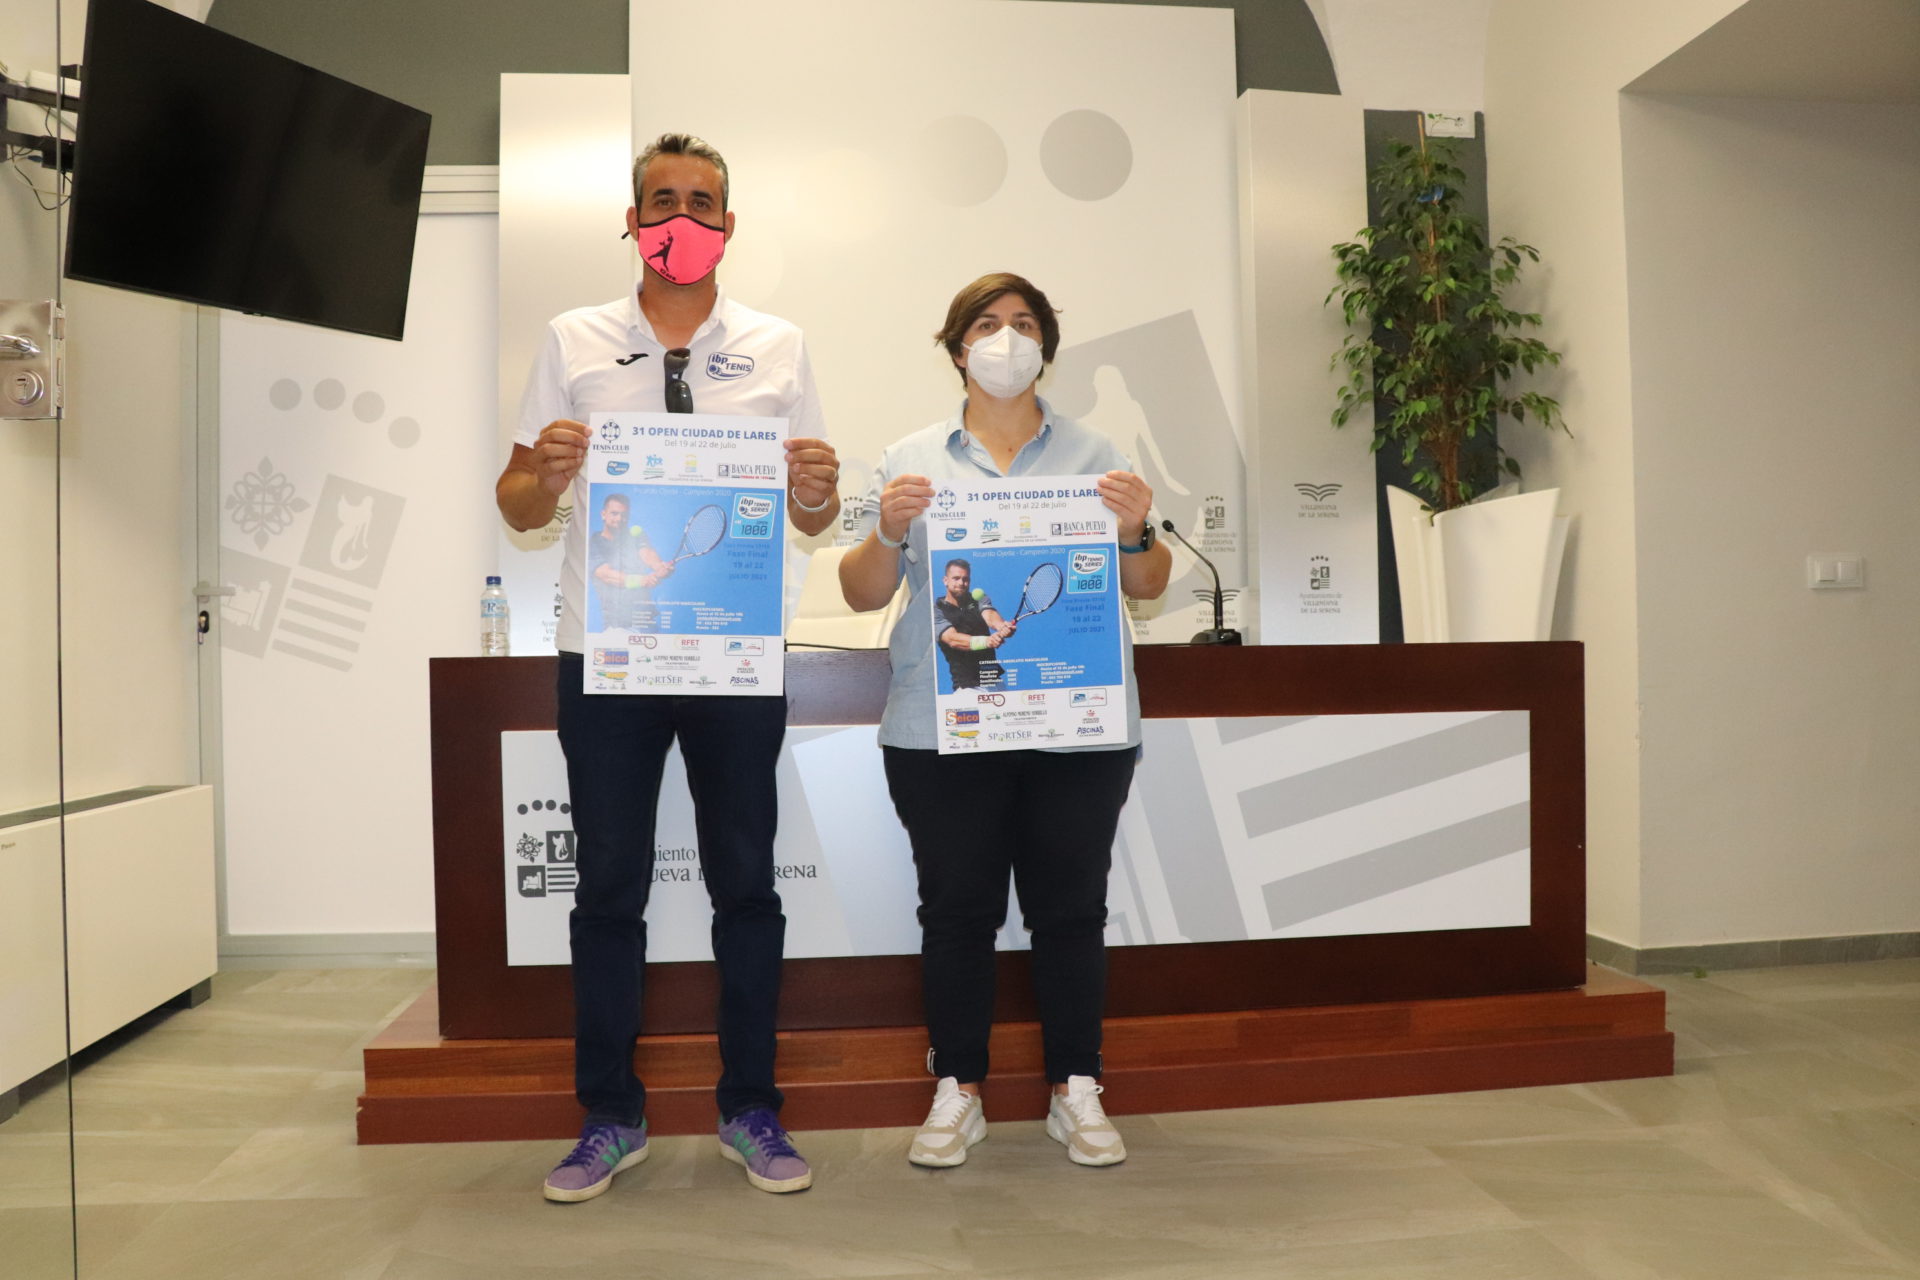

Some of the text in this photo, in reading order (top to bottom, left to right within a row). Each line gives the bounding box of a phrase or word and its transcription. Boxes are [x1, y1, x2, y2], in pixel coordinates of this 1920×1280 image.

[711, 353, 728, 364] ibp
[725, 363, 752, 372] TENIS
[632, 427, 777, 441] 31 OPEN CIUDAD DE LARES
[664, 439, 677, 447] Del
[679, 440, 689, 448] 19
[690, 440, 697, 448] al
[720, 441, 737, 450] Julio
[731, 464, 777, 475] BANCA PUEYO
[967, 493, 979, 502] 31
[982, 491, 1011, 501] OPEN
[1013, 490, 1054, 500] CIUDAD
[1057, 489, 1070, 498] DE
[740, 498, 754, 507] ibp
[1012, 502, 1021, 510] 19
[1051, 501, 1067, 509] Julio
[741, 524, 768, 536] 1000
[1063, 520, 1107, 532] BANCA PUEYO
[1075, 554, 1088, 562] ibp
[1077, 580, 1103, 591] 1000
[729, 676, 759, 685] PISCINAS
[1076, 726, 1105, 735] PISCINAS
